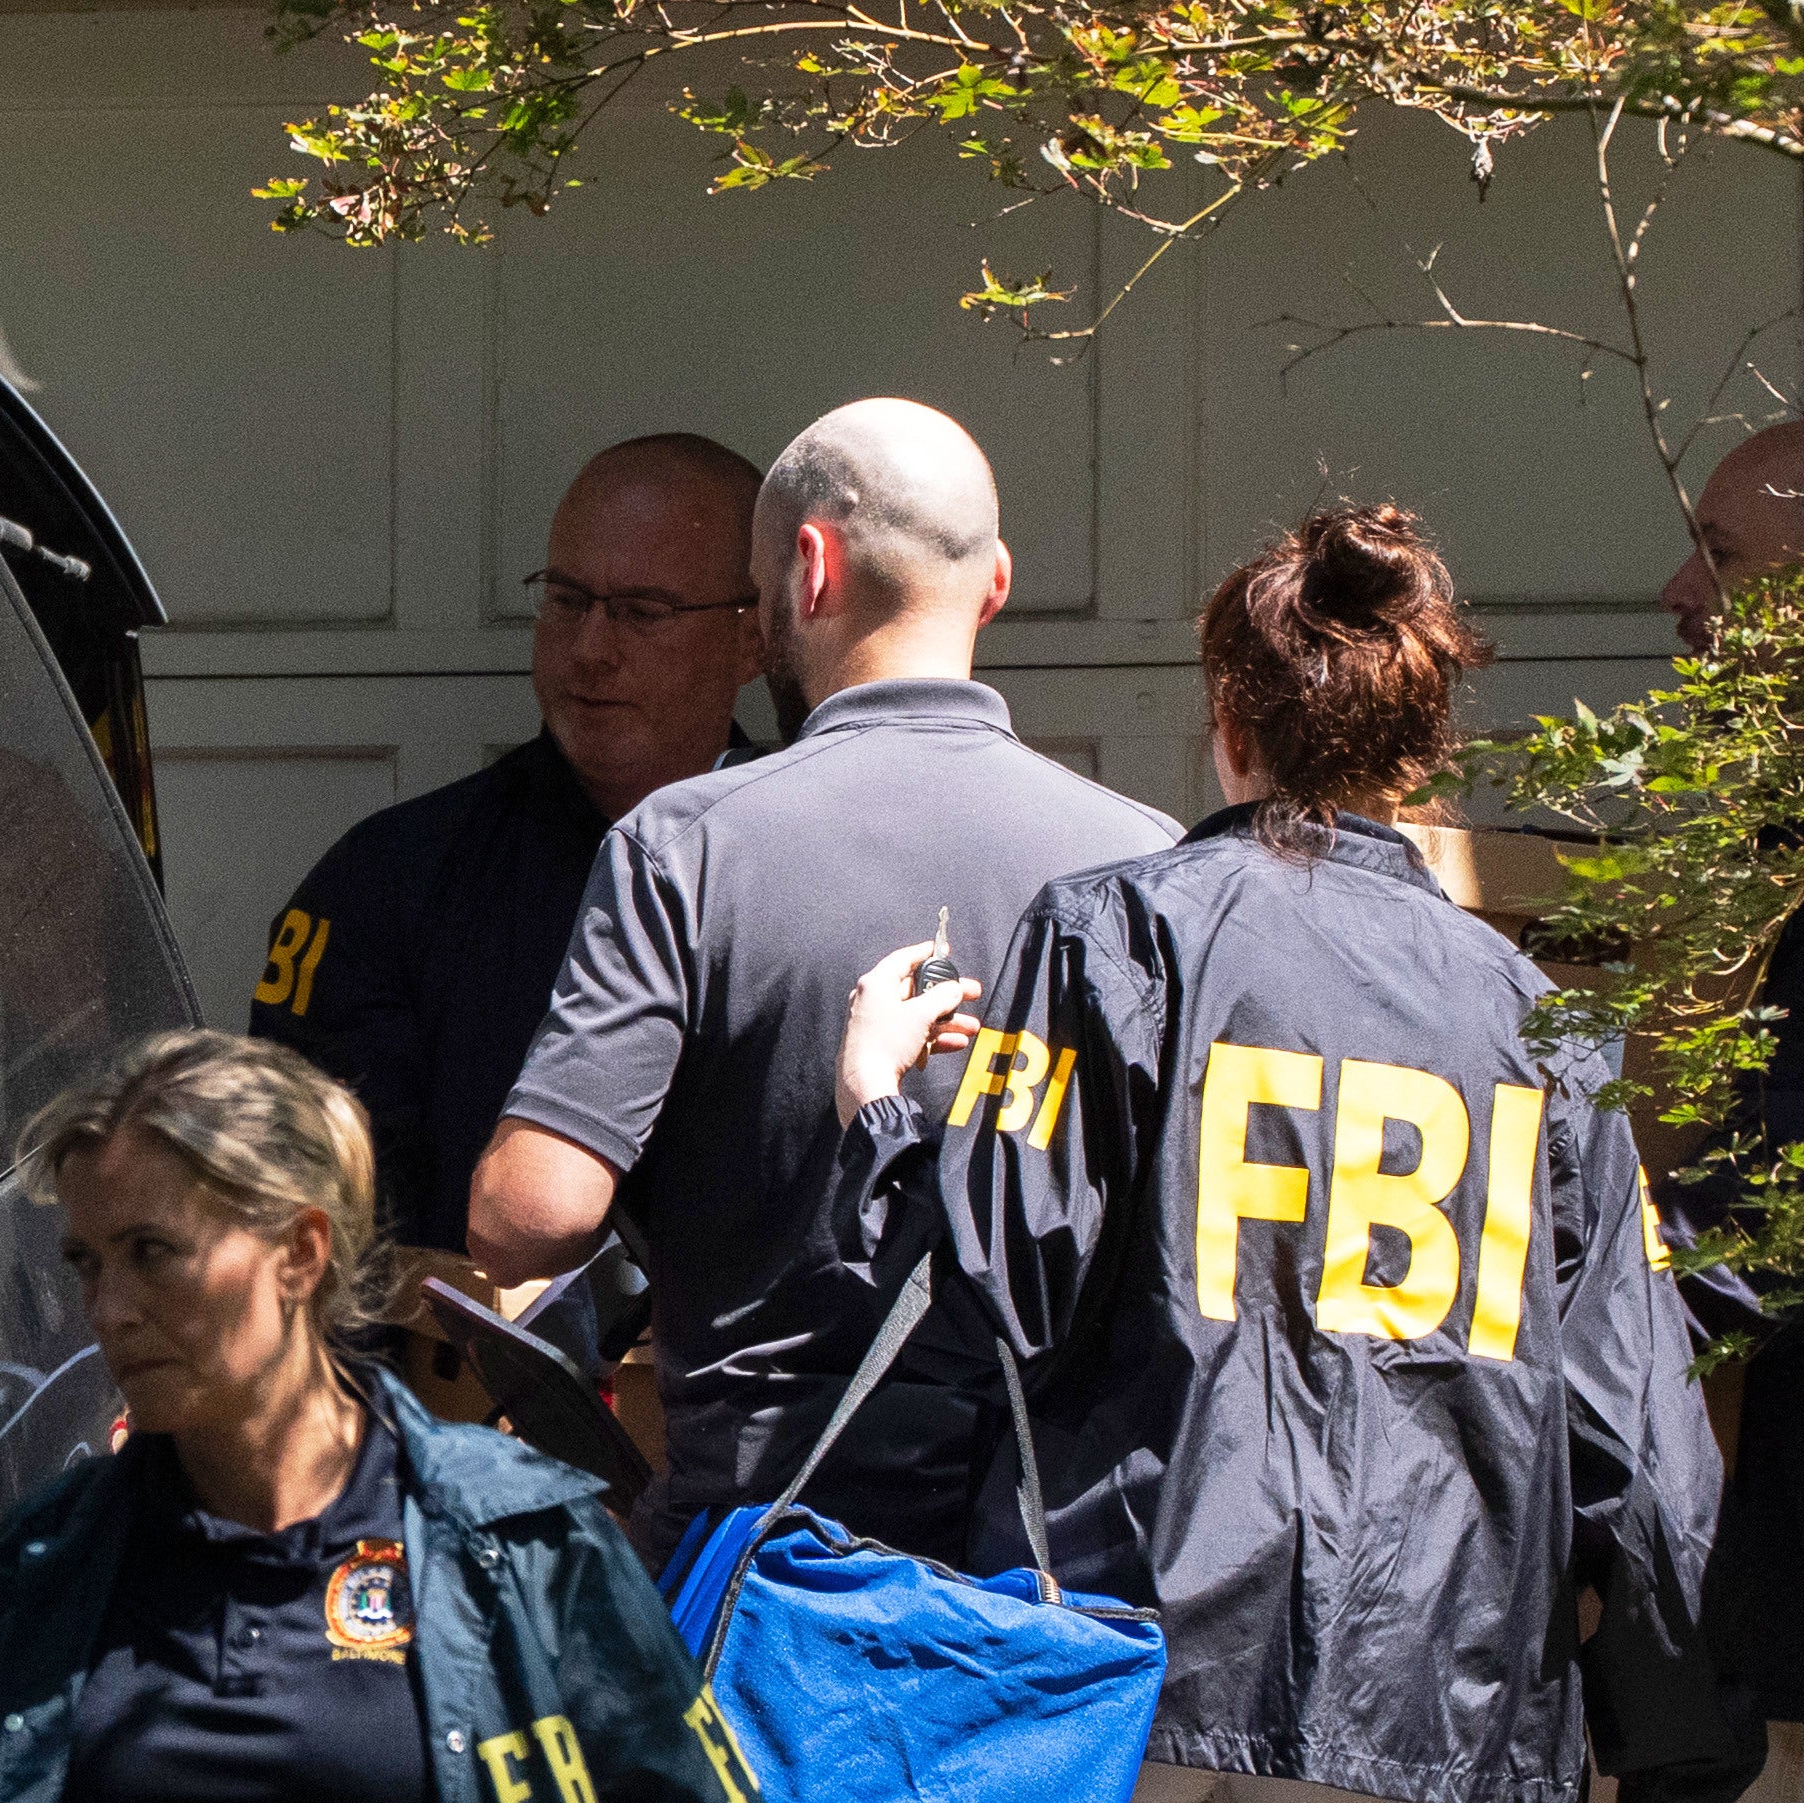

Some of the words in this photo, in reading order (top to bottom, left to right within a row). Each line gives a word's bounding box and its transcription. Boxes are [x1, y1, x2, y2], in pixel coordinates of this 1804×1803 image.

[254, 909, 330, 1015] BI
[948, 1026, 1077, 1150] FBI
[1195, 1040, 1545, 1361] FBI
